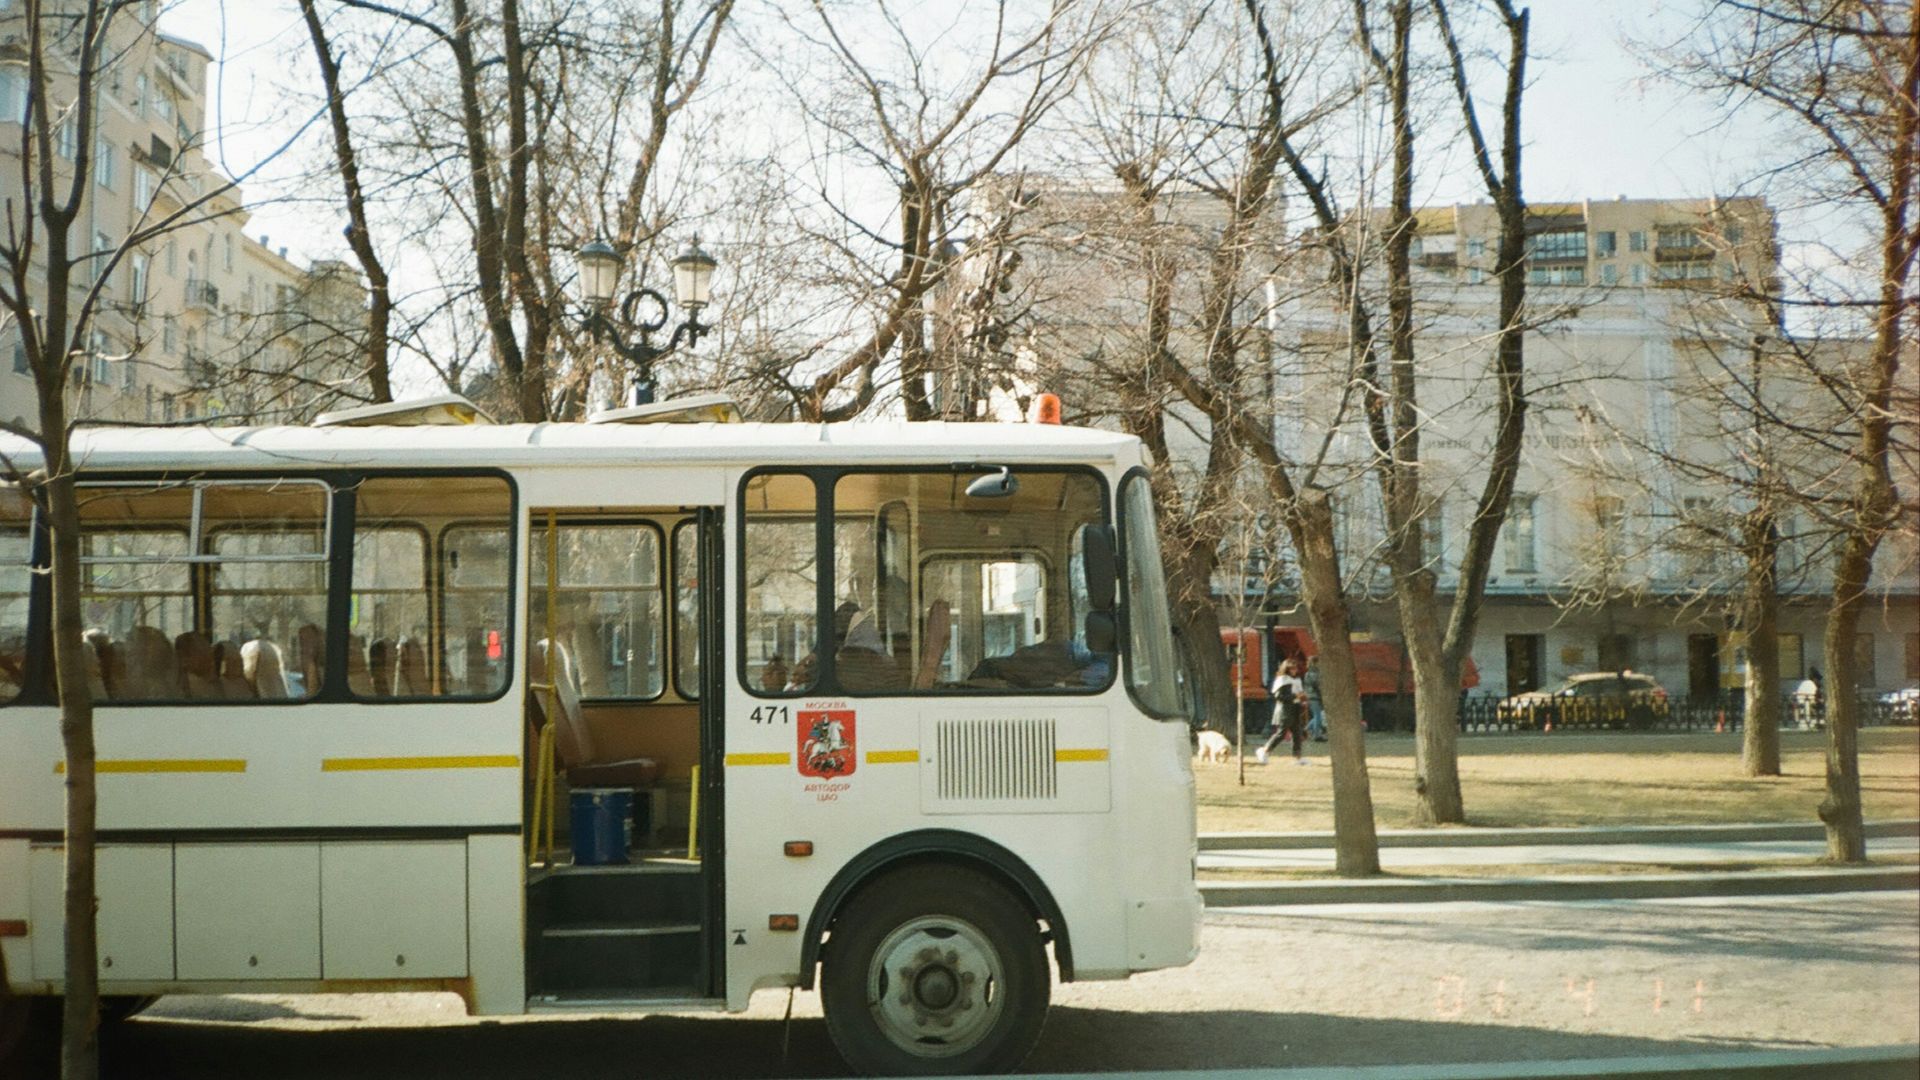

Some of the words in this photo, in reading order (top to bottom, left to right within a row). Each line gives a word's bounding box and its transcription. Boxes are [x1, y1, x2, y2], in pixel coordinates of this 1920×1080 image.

[750, 706, 788, 724] 471
[804, 783, 850, 792] АВТОДОР
[816, 793, 838, 802] ЦАО
